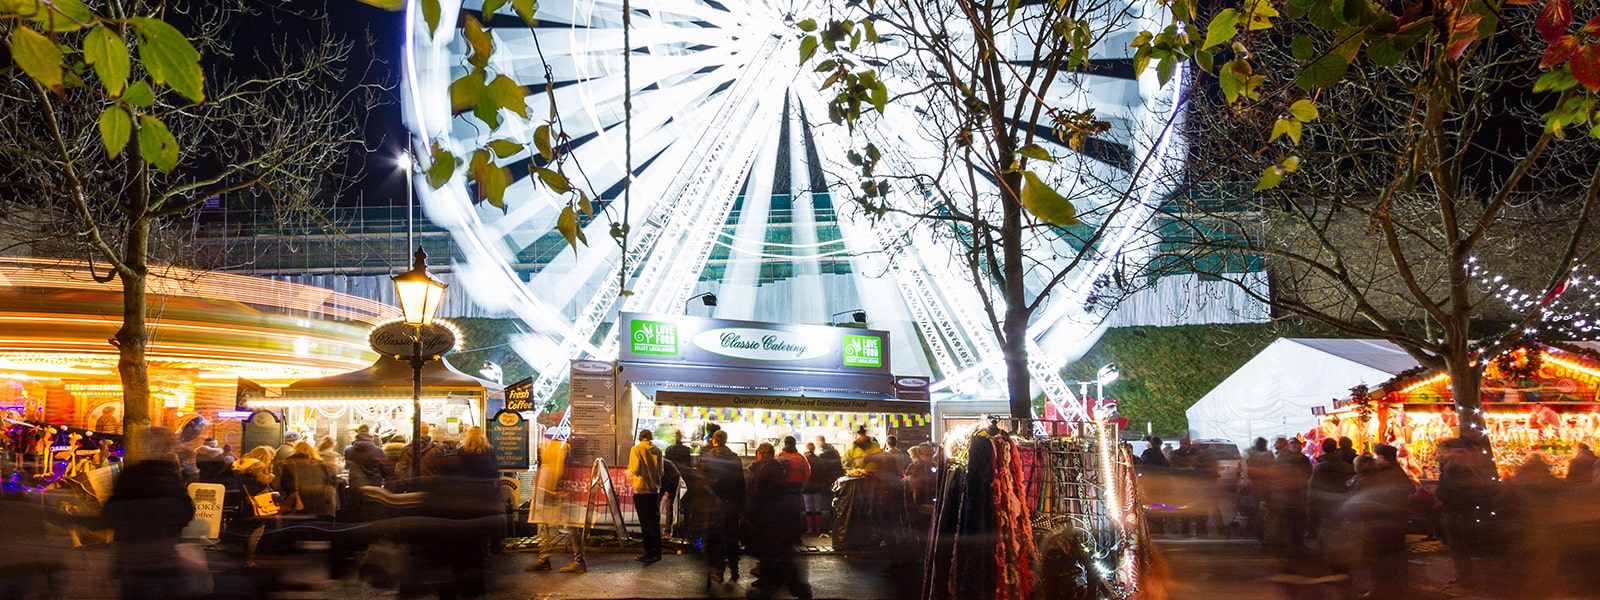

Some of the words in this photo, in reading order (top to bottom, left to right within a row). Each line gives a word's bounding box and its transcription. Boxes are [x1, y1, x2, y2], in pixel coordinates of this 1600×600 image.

[655, 324, 675, 335] LOVE
[374, 331, 413, 346] Classic
[655, 335, 675, 345] FOOD
[862, 338, 879, 348] LOVE
[720, 332, 760, 350] Classic
[761, 335, 807, 358] Catering
[862, 347, 879, 357] FOOD
[509, 389, 530, 399] Fresh
[507, 401, 533, 410] Coffee
[733, 396, 758, 406] Quality
[760, 397, 782, 407] Locally
[784, 399, 815, 407] Produced
[817, 400, 850, 408] Traditional
[196, 503, 221, 511] OKES
